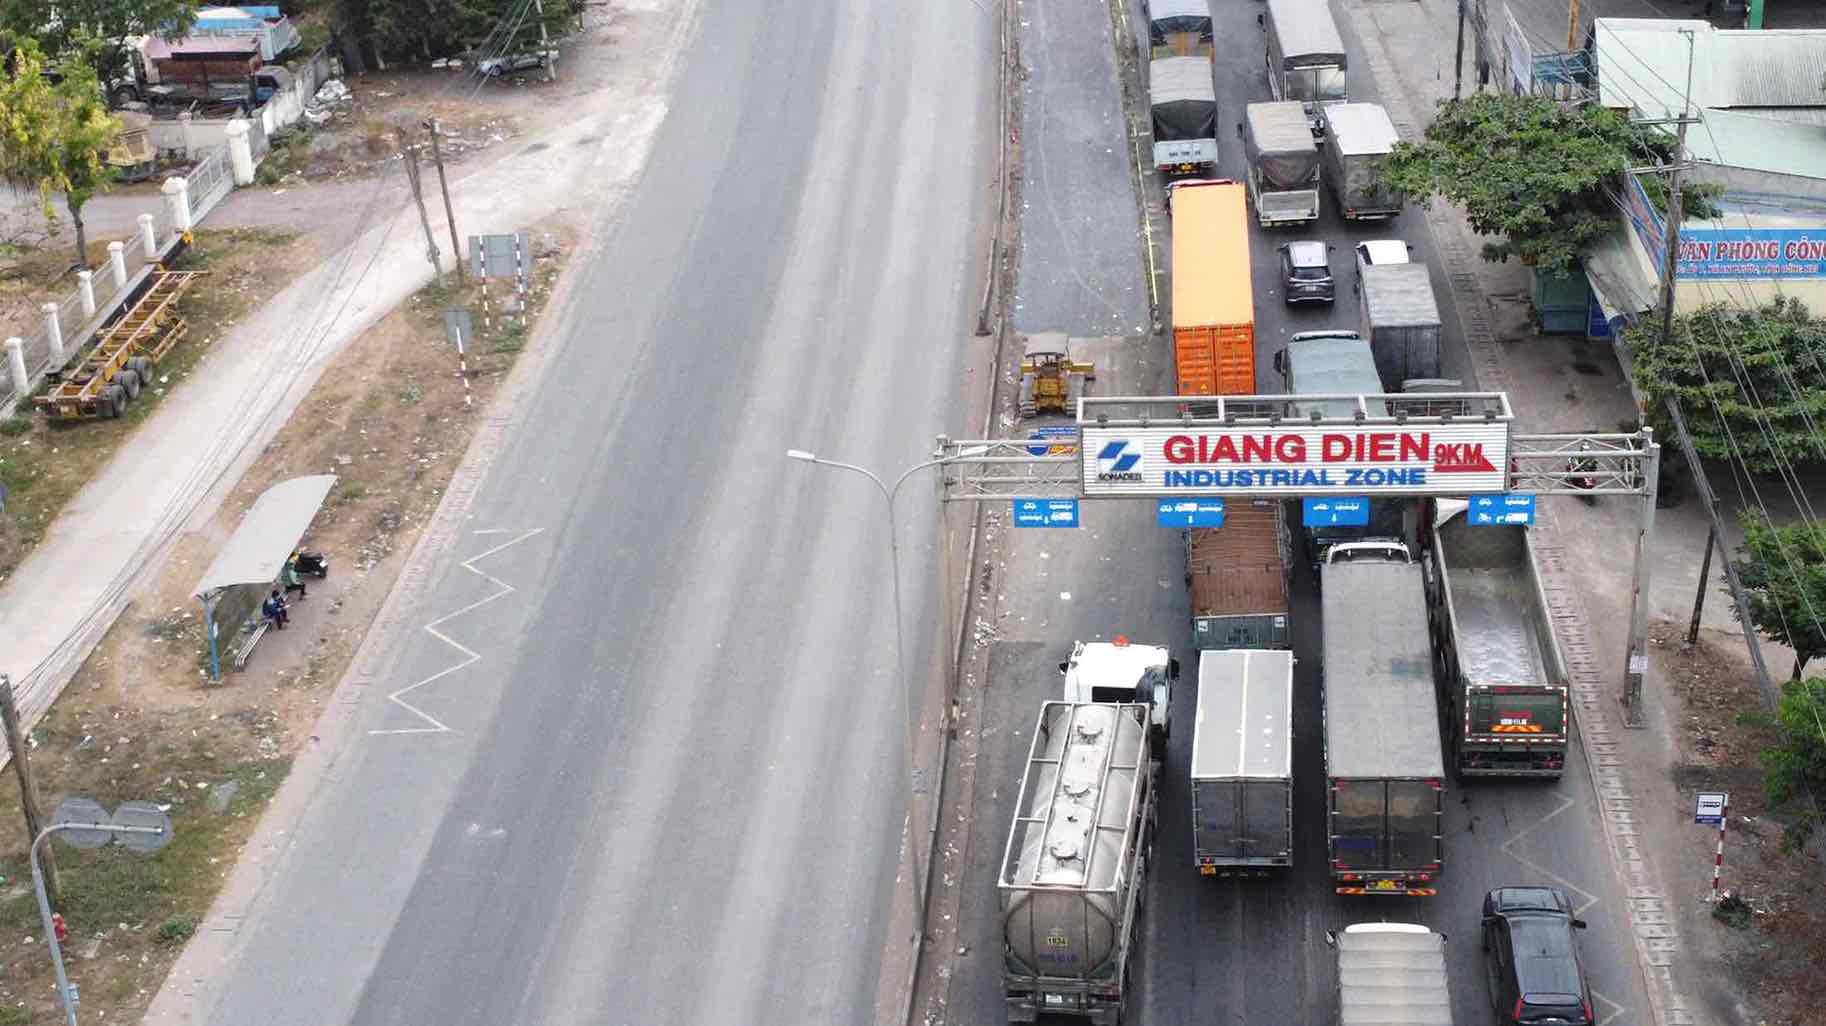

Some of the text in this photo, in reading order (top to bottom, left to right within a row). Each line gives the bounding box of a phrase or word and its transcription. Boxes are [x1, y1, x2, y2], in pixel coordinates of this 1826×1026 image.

[1717, 237, 1778, 261] PHÒNG
[1163, 432, 1483, 465] GIANG DIEN 9KM
[1164, 468, 1427, 487] INDUSTRIAL ZONE
